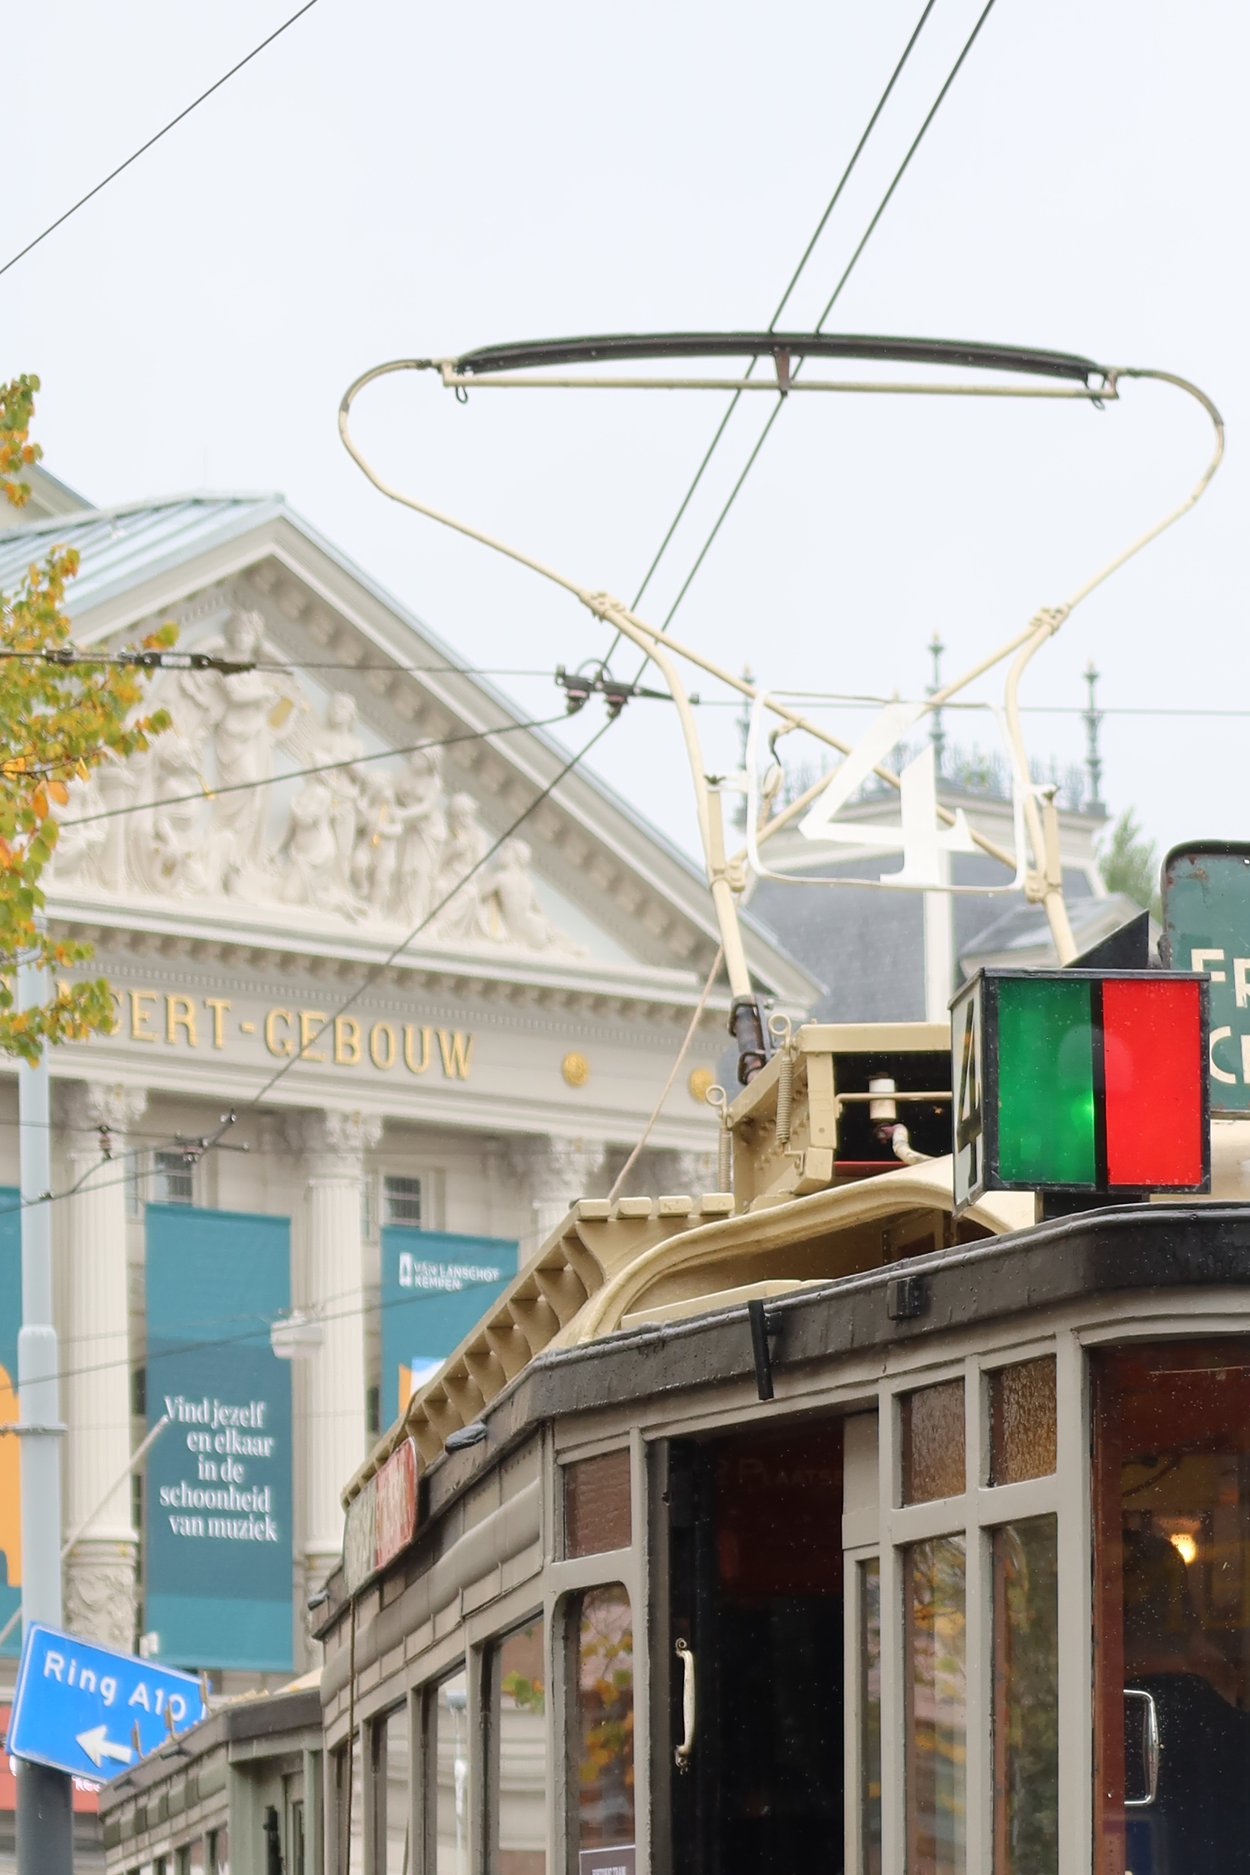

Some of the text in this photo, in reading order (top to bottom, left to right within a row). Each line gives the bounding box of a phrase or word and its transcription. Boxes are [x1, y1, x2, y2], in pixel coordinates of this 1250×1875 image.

[956, 997, 982, 1190] 4
[164, 1395, 266, 1430] Vind jezelf
[186, 1426, 275, 1458] en elkaar
[197, 1454, 245, 1484] in de
[159, 1479, 272, 1514] schoonheid
[168, 1513, 279, 1543] van muziek
[43, 1650, 188, 1723] Ring A10
